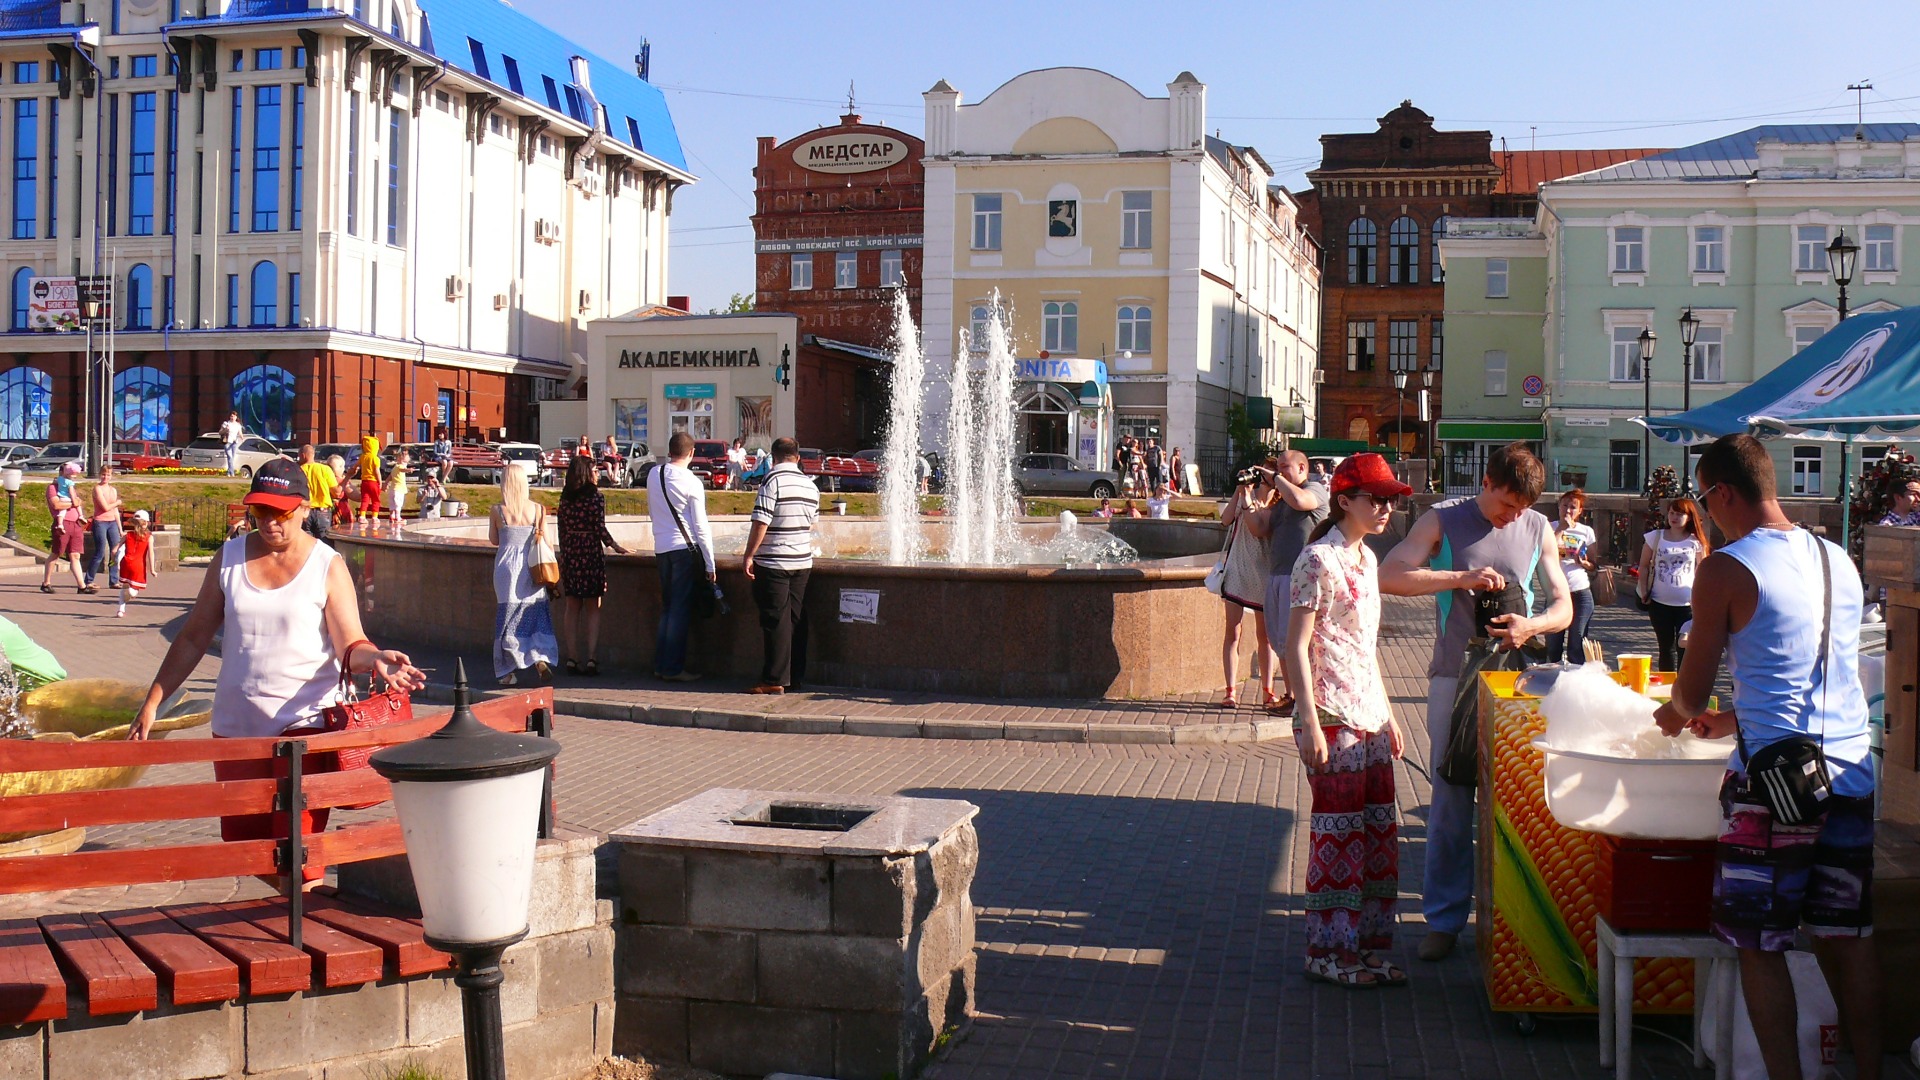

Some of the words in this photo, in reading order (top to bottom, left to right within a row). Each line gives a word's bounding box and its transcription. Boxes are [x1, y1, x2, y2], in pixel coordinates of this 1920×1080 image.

[808, 142, 894, 161] МЕДСТАР
[795, 241, 840, 250] ПОБЕЖДАЕТ
[897, 237, 923, 245] КАРИЕ
[53, 286, 70, 299] 190
[618, 347, 760, 368] АКАДЕМКНИГА
[1014, 360, 1072, 377] ONITA
[260, 476, 291, 489] РОССИЯ
